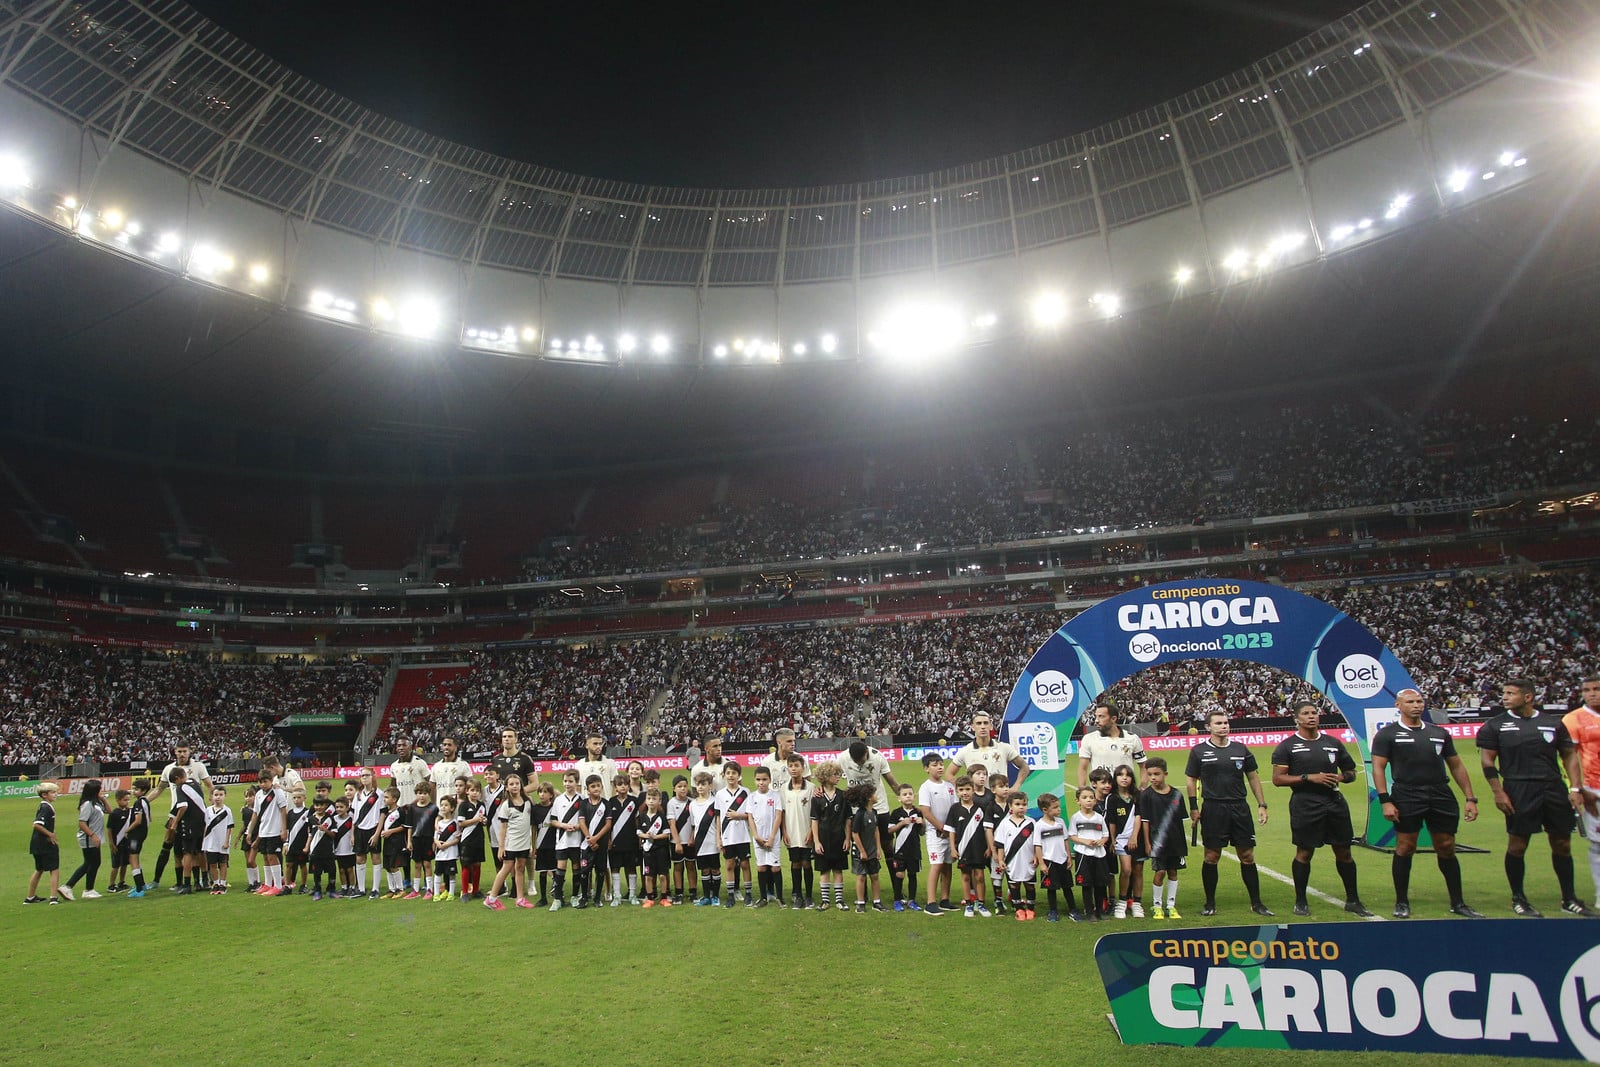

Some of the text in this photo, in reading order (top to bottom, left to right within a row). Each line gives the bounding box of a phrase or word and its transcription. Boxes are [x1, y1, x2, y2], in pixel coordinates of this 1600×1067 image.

[1152, 584, 1240, 600] campeonato
[1118, 596, 1280, 632] CARIOCA
[1131, 632, 1274, 654] bet nacional 2023
[1342, 664, 1379, 681] bet
[1036, 680, 1068, 696] bet
[1018, 736, 1034, 745] CA
[1149, 737, 1187, 749] SAÚDE
[1019, 746, 1040, 755] RIO
[1041, 745, 1049, 765] 2023
[657, 757, 683, 768] VOCÊ
[68, 777, 121, 794] BENO
[1149, 936, 1340, 965] campeonato
[1148, 965, 1559, 1043] CARIOCA
